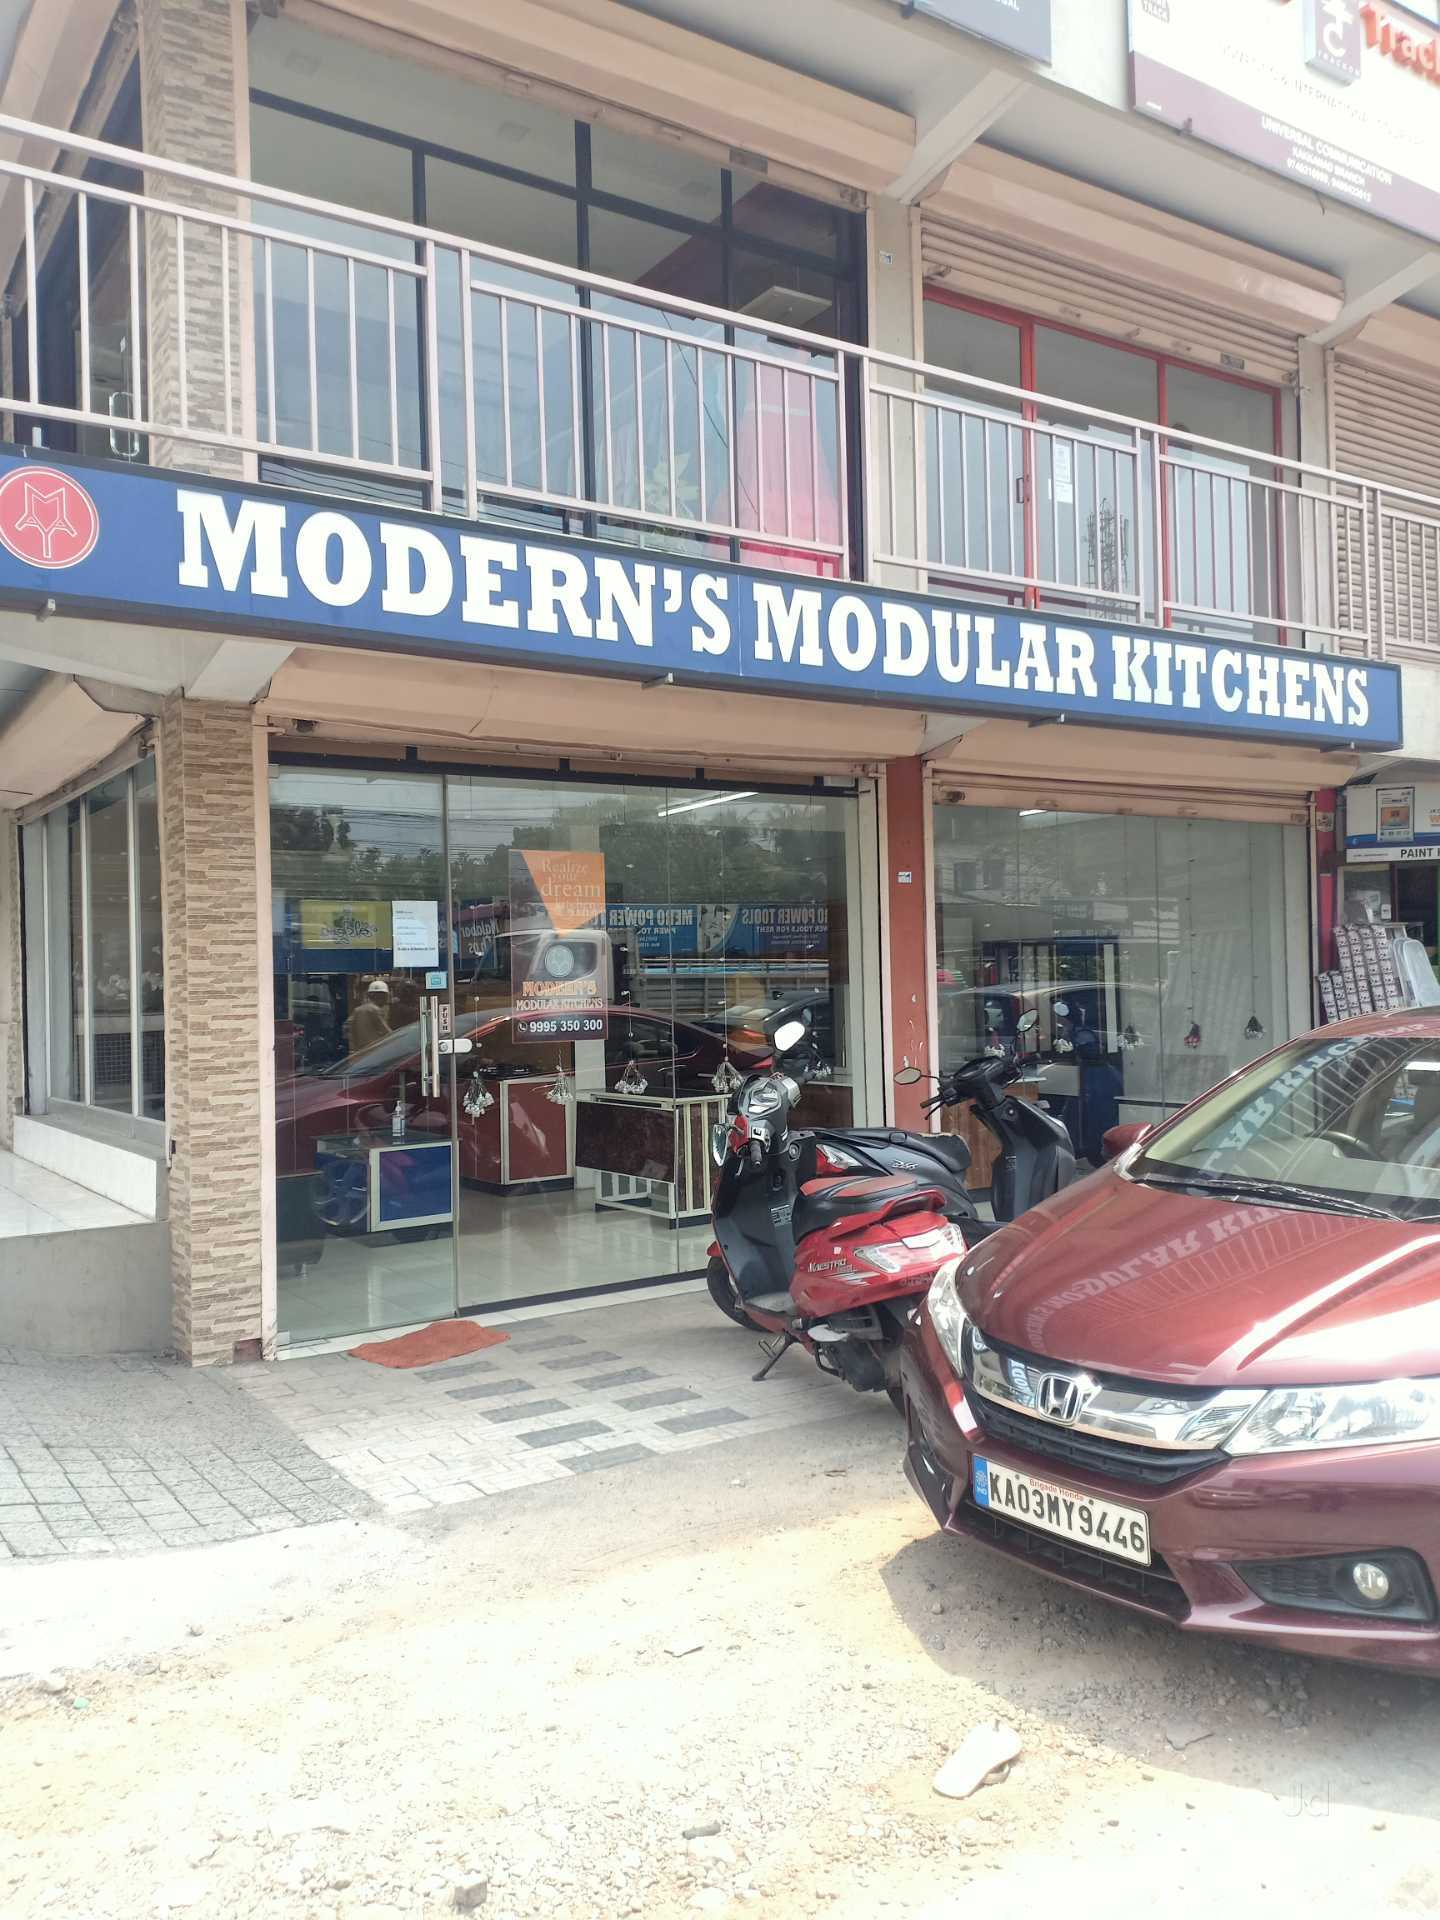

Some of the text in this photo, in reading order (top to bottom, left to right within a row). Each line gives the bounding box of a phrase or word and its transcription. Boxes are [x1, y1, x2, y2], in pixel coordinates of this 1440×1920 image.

[177, 489, 1369, 727] MODERN'S MODULAR KITCHENS
[1400, 847, 1434, 859] PAINT
[541, 876, 600, 897] dream
[529, 1018, 603, 1033] 9995 350 300
[1030, 1478, 1085, 1501] Brigade Honda
[989, 1471, 1145, 1553] KA03MY9446
